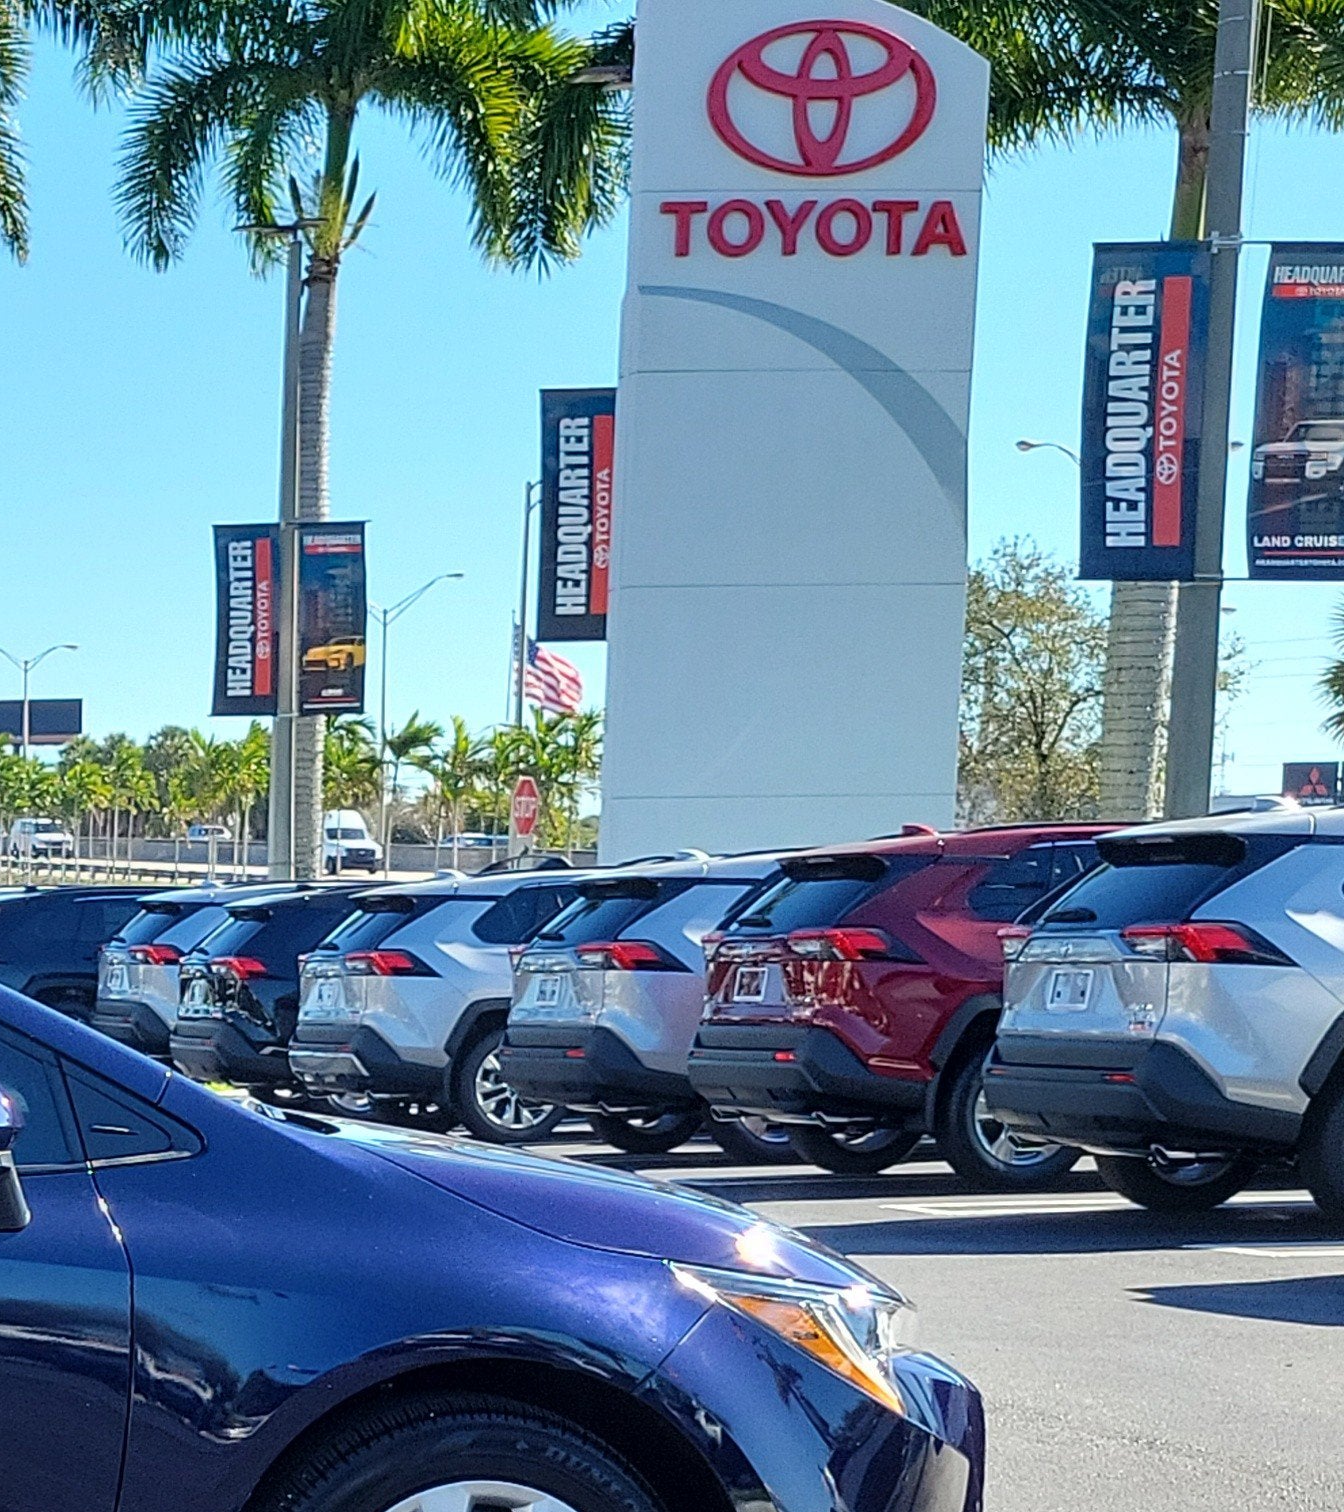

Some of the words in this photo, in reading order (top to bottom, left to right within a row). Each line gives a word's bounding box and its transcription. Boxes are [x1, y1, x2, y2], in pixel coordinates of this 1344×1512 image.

[660, 199, 967, 258] TOYOTA
[1106, 278, 1157, 547] HEADQUARTER
[1159, 349, 1182, 451] TOYOTA
[555, 416, 590, 616] HEADQUARTER
[594, 469, 610, 542] TOYOTA
[1253, 535, 1291, 548] LAND
[227, 540, 253, 697] HEADQUARTER
[258, 580, 270, 639] TOYOTA
